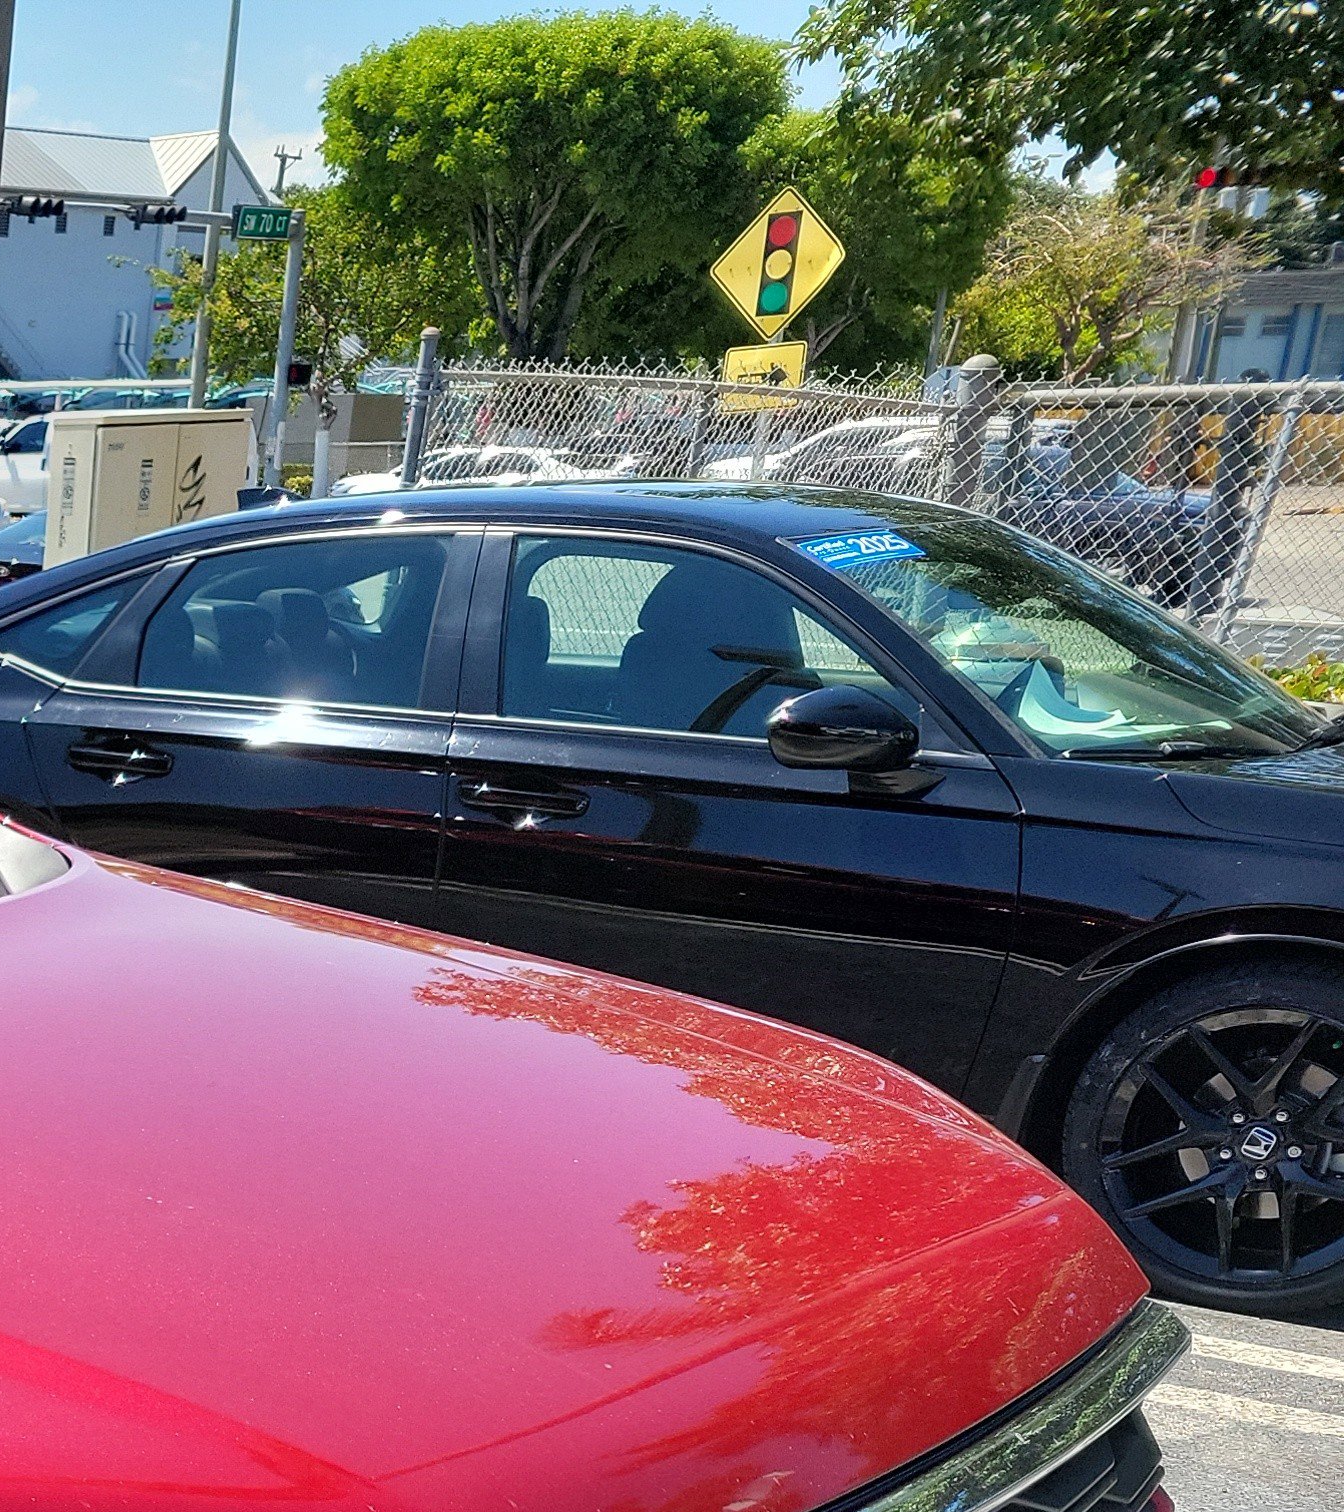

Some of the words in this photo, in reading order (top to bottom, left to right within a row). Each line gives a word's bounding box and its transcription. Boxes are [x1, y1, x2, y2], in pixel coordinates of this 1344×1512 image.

[259, 213, 274, 233] 70
[276, 216, 288, 232] CT
[847, 534, 910, 554] 2025
